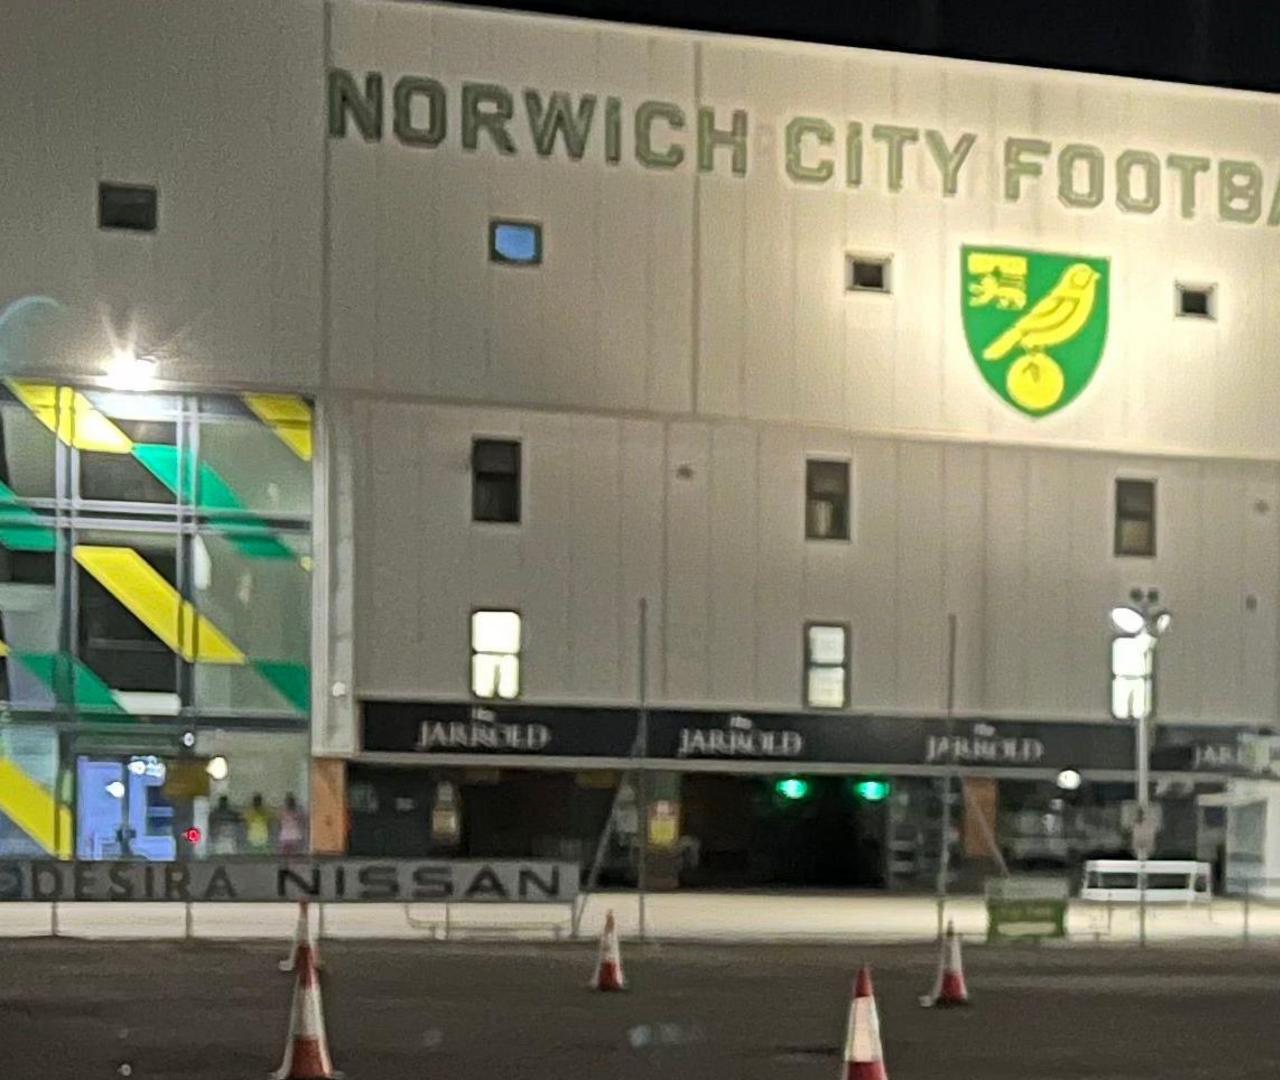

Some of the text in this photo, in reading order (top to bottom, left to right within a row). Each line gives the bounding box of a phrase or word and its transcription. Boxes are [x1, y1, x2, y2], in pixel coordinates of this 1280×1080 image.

[327, 67, 748, 177] NORWICH
[784, 116, 977, 197] CITY
[415, 720, 552, 752] JARROLD
[679, 727, 803, 757] JARROLD
[926, 735, 1045, 763] JARROLD
[30, 861, 561, 900] DESIRA NISSAN
